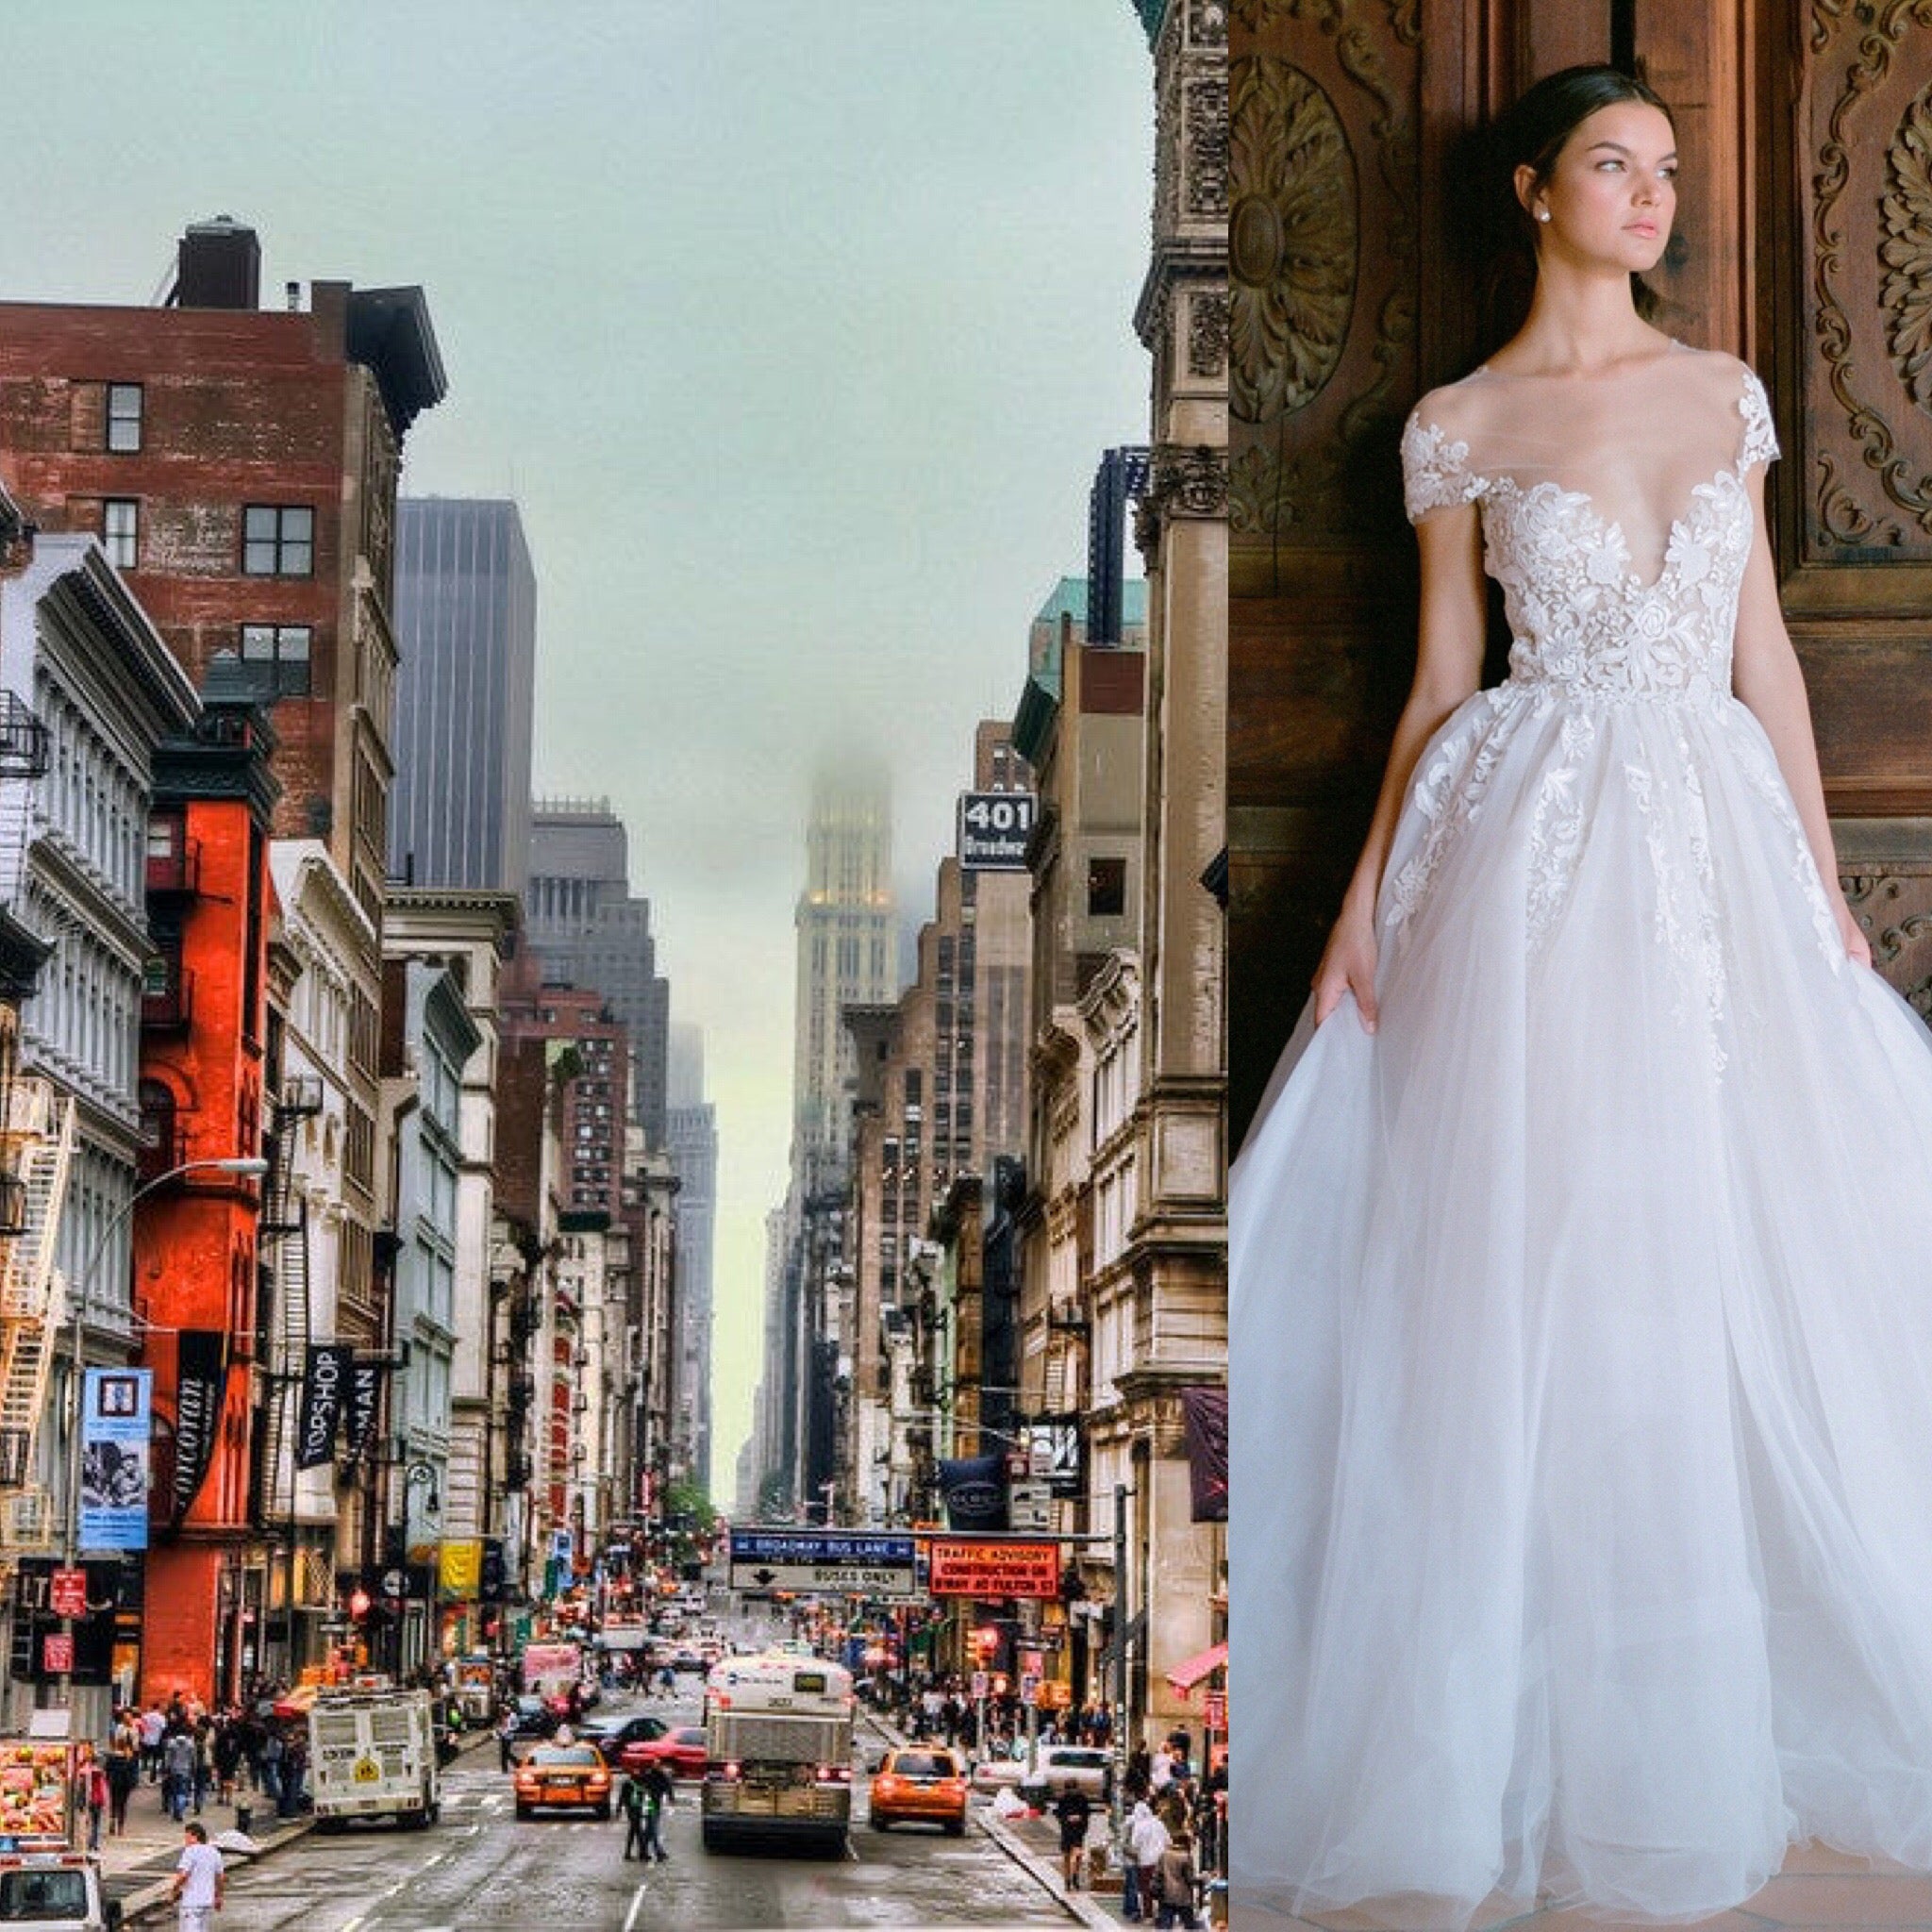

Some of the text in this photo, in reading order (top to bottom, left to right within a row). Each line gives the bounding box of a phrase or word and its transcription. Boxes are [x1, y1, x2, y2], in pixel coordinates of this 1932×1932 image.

[965, 801, 1030, 830] 401
[303, 1352, 339, 1461] TOPSHOP
[861, 1571, 895, 1584] ONLY
